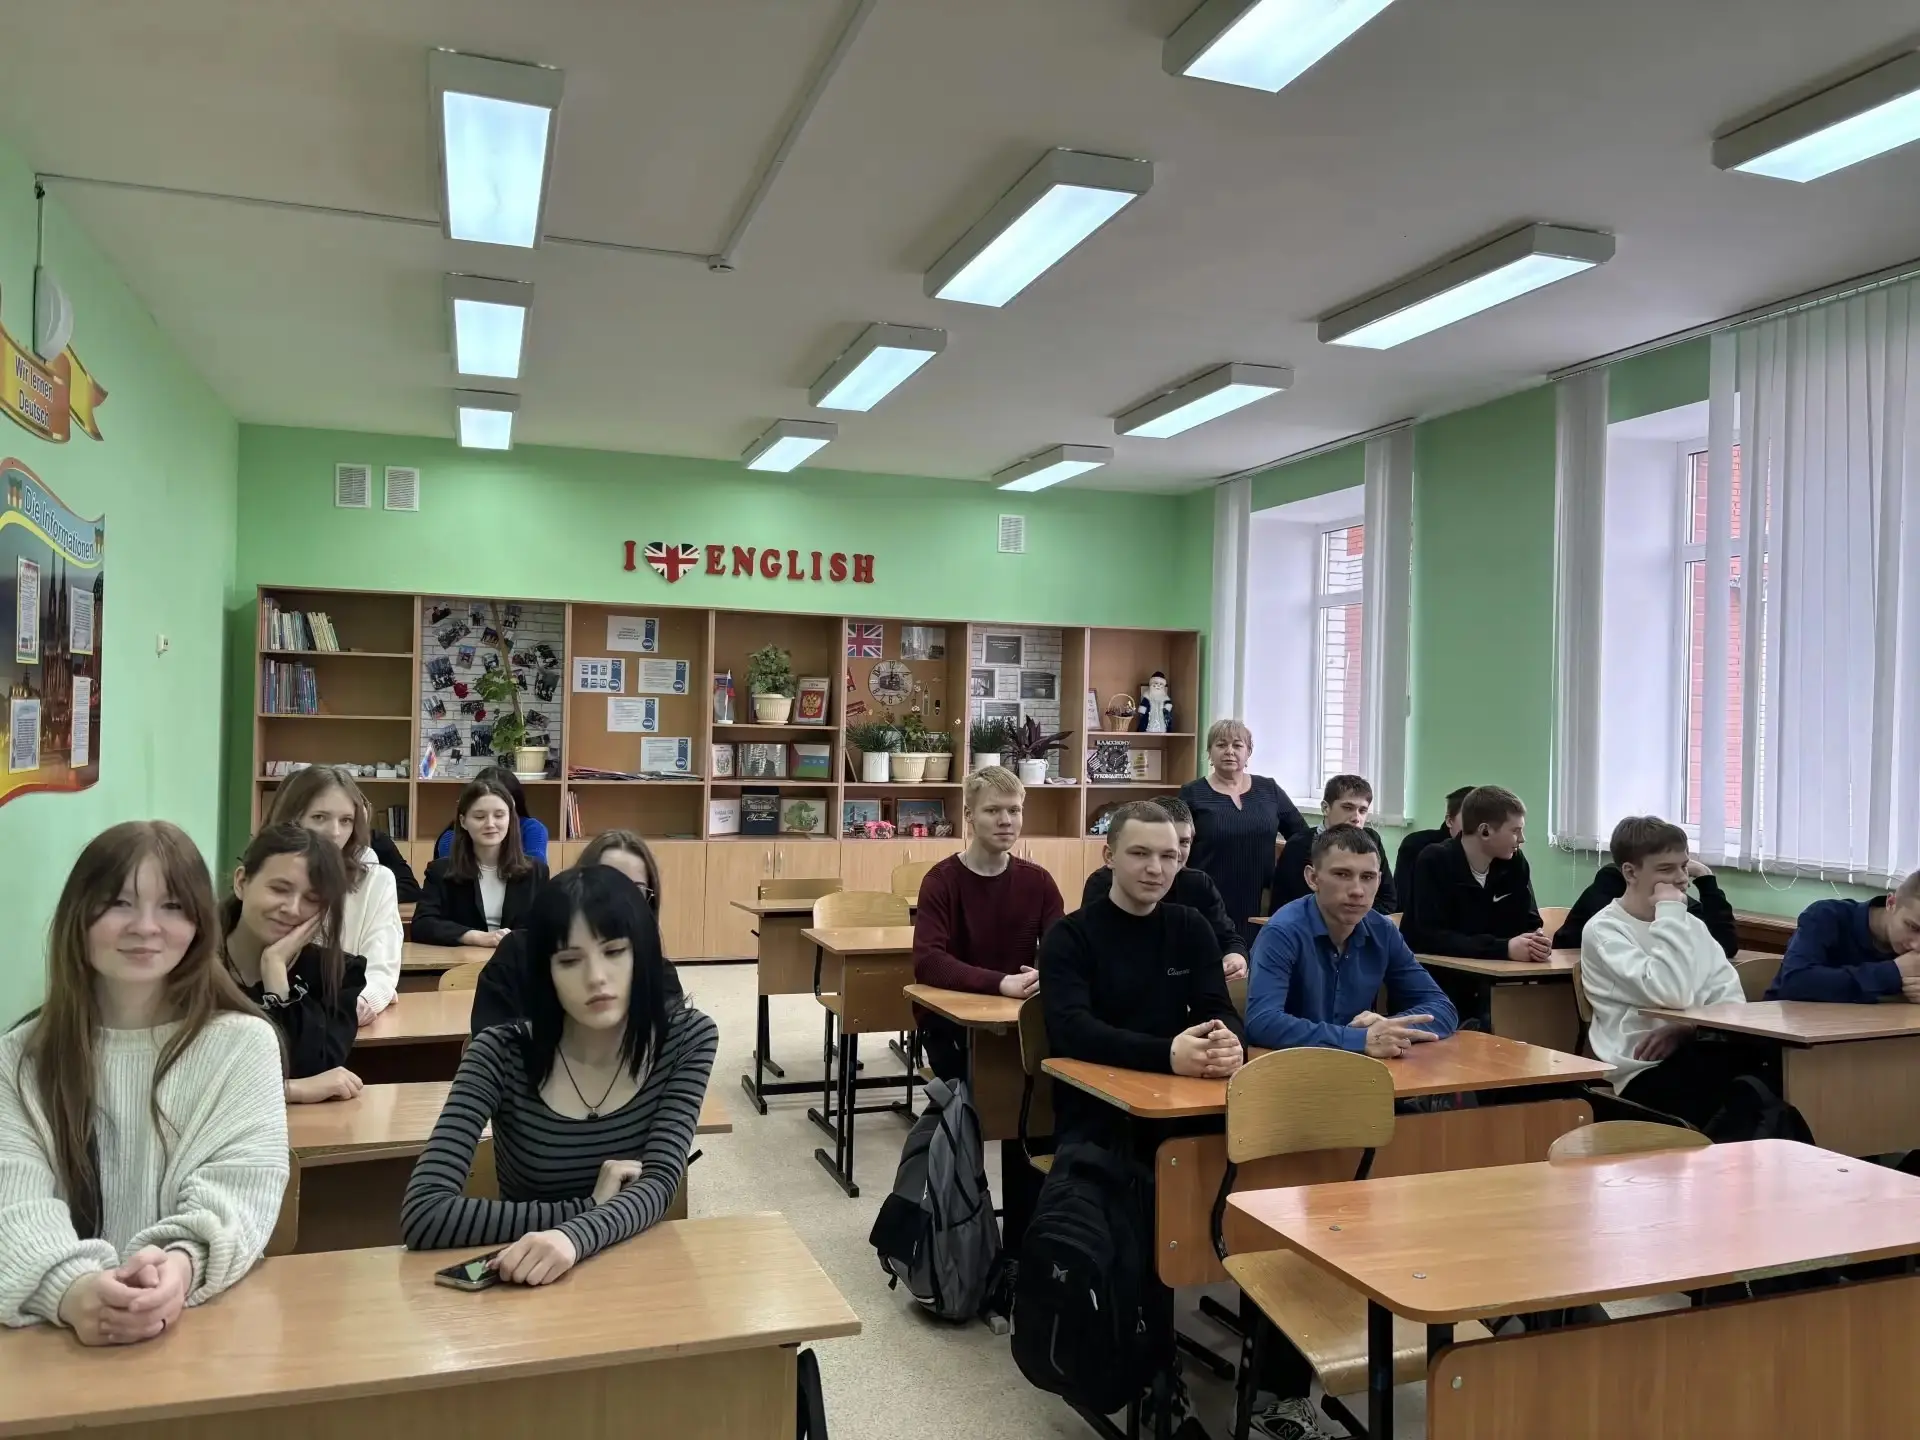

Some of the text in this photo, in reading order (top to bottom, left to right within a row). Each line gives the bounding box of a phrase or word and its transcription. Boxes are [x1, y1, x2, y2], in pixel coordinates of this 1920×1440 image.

[15, 353, 54, 402] Wir lernen
[19, 387, 50, 429] Deutsch
[24, 485, 94, 561] Die Informationen
[624, 540, 875, 584] I ENGLISH
[889, 661, 896, 669] 12
